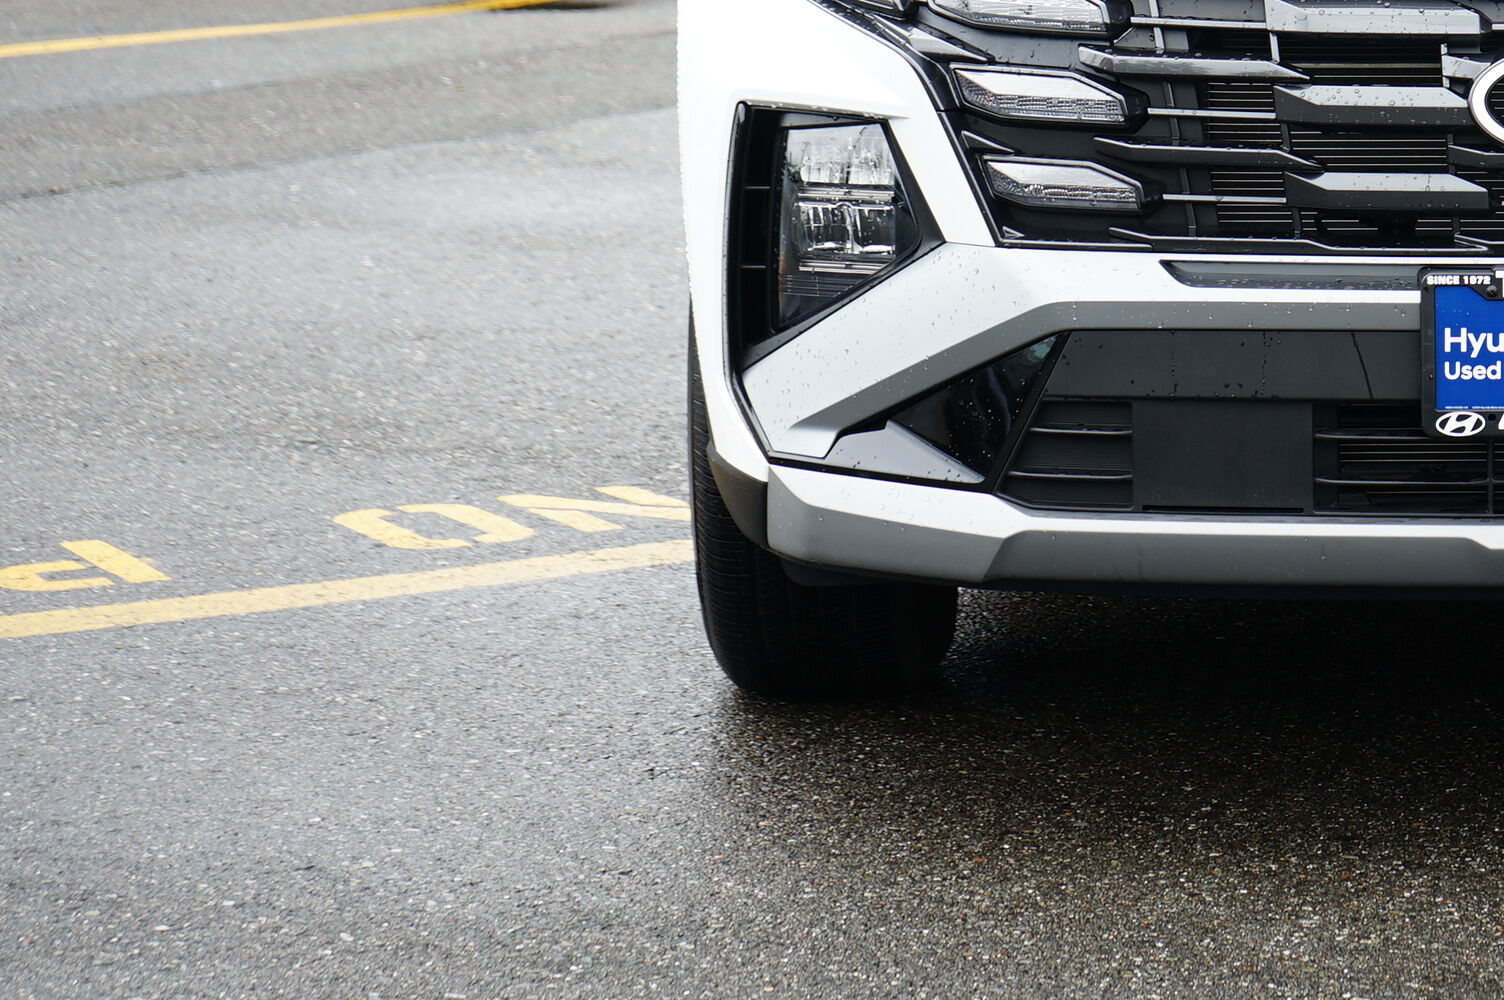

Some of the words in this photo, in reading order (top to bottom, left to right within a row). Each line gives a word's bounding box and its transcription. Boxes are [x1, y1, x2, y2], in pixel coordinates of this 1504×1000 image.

[1427, 275, 1460, 285] SINCE
[1463, 275, 1491, 285] 1972
[1444, 361, 1501, 380] Used
